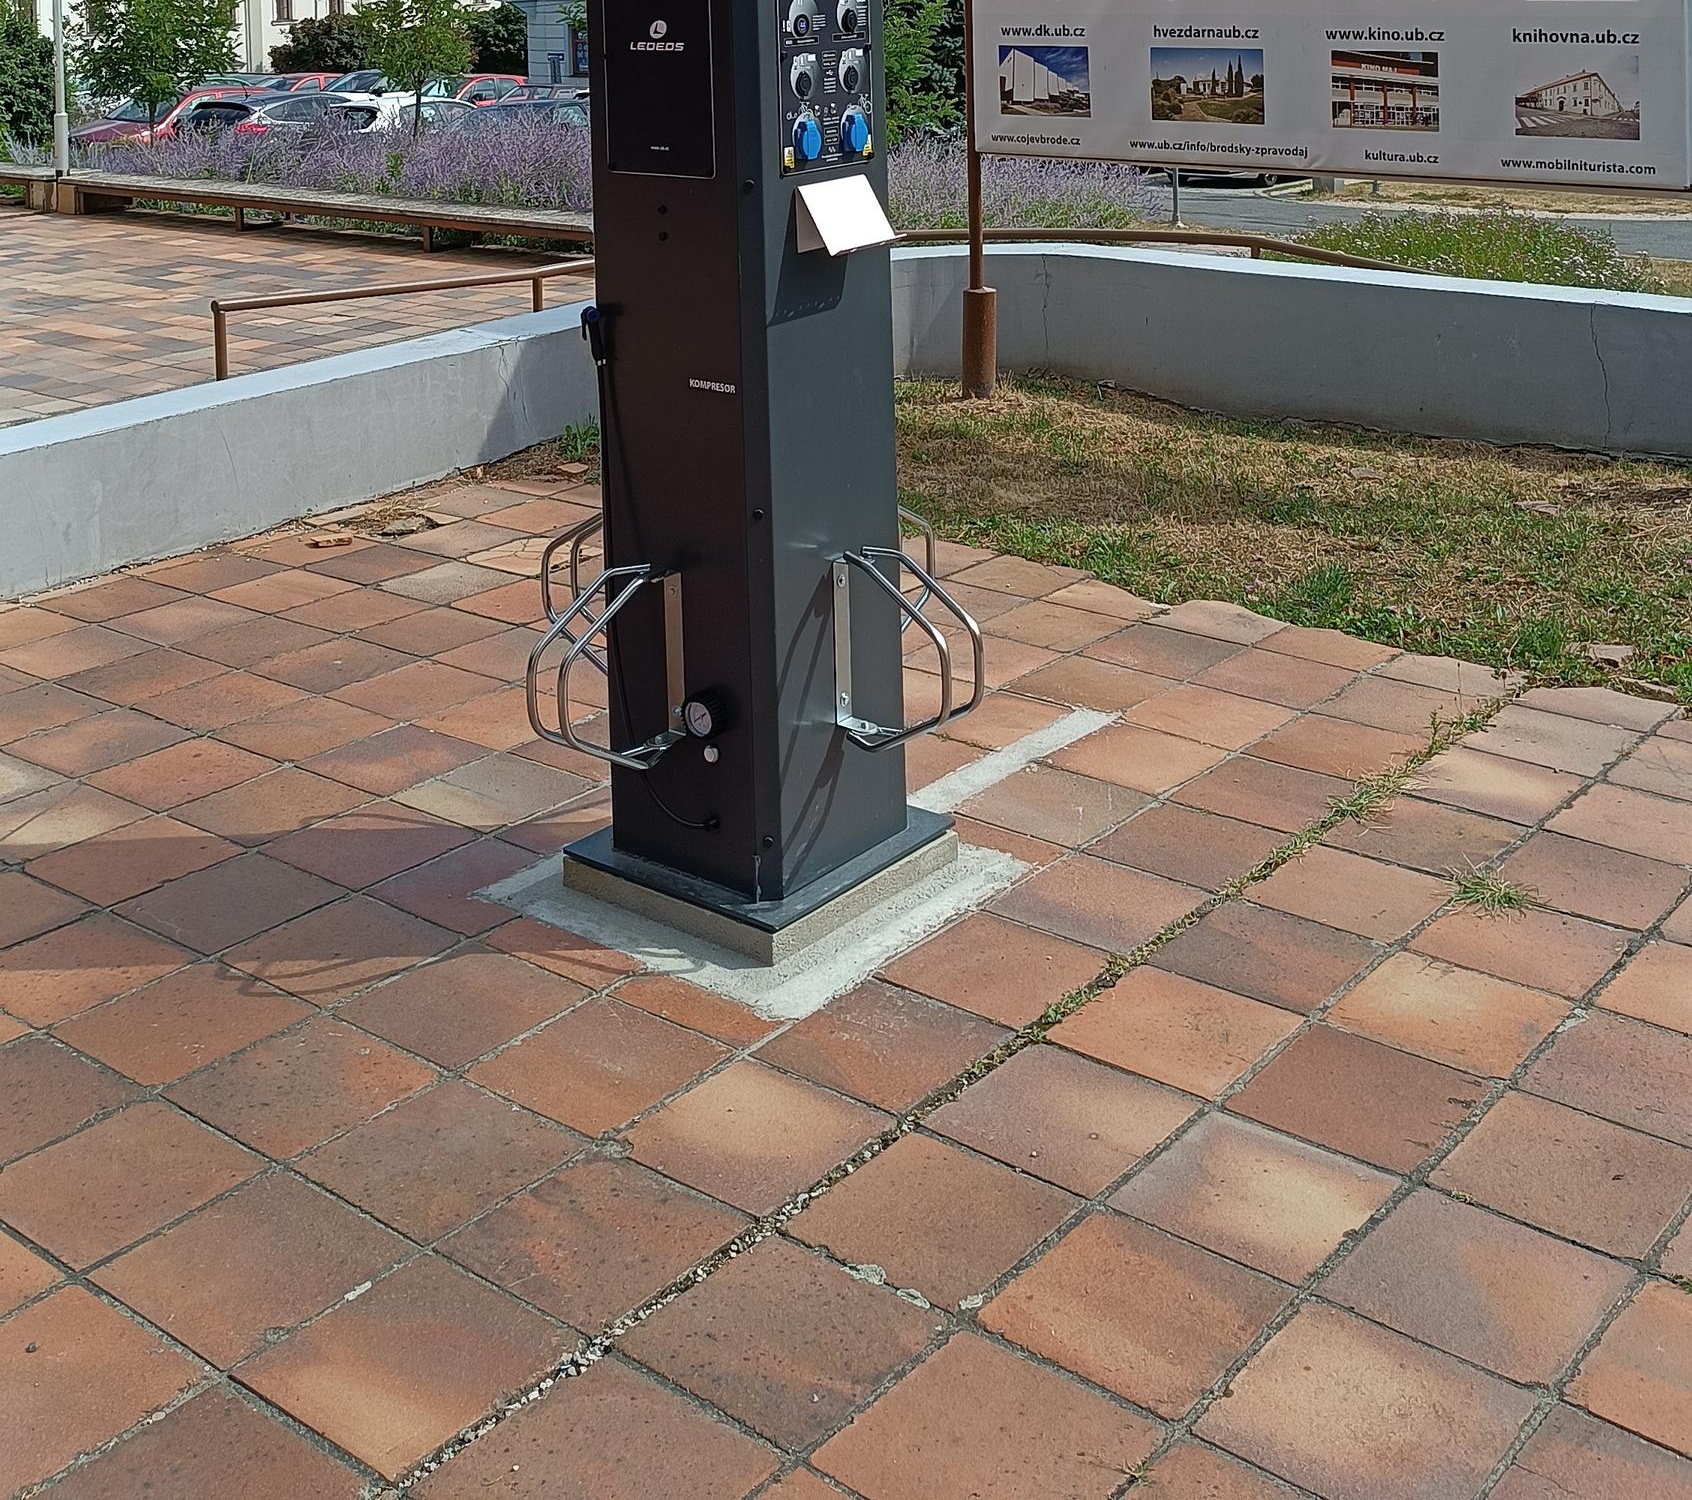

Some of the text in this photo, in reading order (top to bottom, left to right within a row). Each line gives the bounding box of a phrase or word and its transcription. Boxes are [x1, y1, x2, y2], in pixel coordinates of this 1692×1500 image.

[1001, 24, 1086, 37] www.dk.ub.cz
[1153, 25, 1259, 39] hvezdarnaub.cz
[1325, 27, 1445, 42] www.kino.ub.cz
[1512, 28, 1640, 45] knihovna.ub.cz
[630, 41, 685, 52] LEDEOS
[1129, 139, 1309, 159] www.ub.cz/info/brodsky-zpravodaj
[1364, 149, 1440, 164] kultura.ub.cz
[1500, 157, 1657, 175] www.mobilniturista.com
[689, 378, 736, 393] KOMPRESOR
